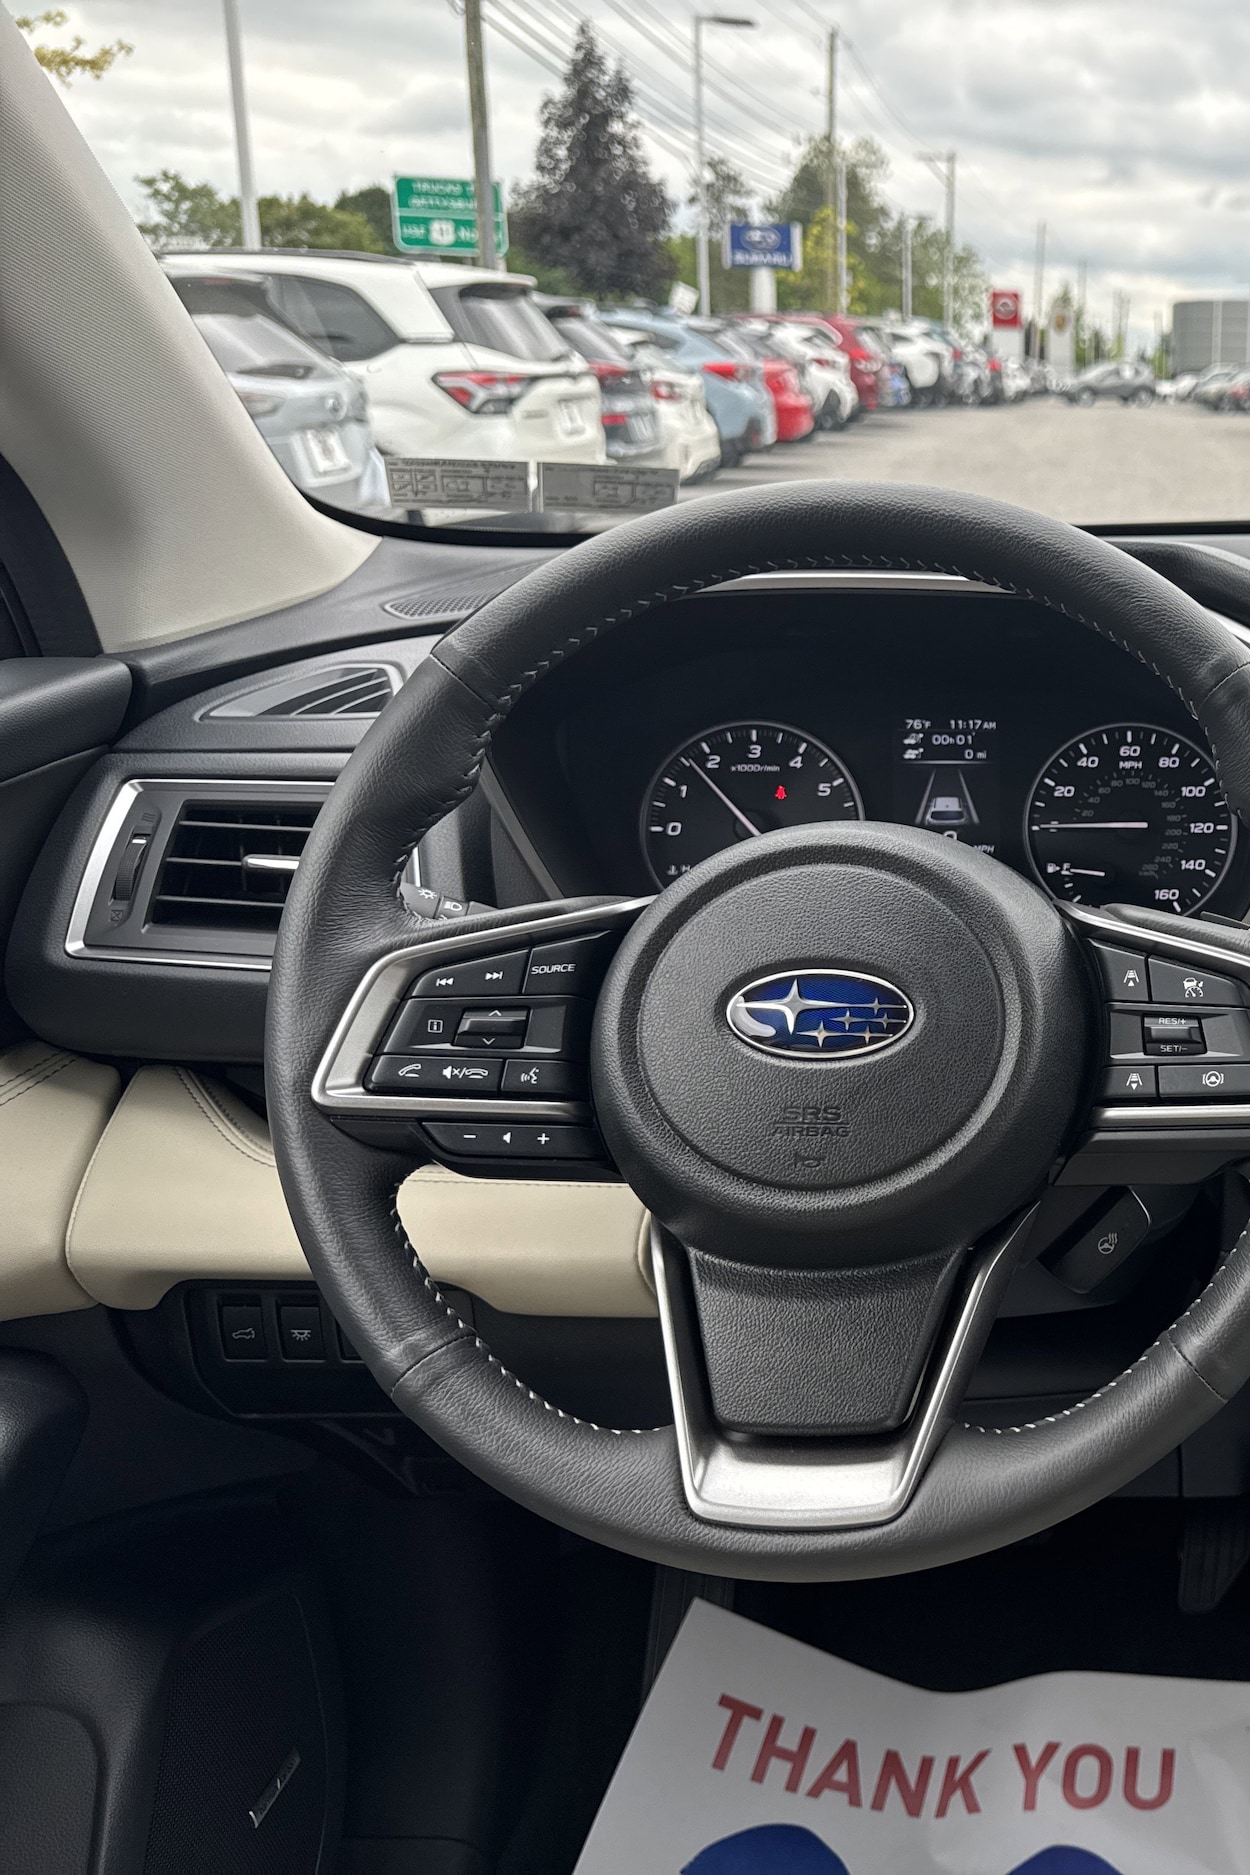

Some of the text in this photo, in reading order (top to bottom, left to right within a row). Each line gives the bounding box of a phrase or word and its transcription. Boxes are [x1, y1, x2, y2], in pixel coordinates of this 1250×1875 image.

[747, 744, 762, 759] 3
[964, 749, 987, 759] 0 mi
[1119, 745, 1141, 757] 60
[706, 755, 721, 769] 2
[789, 756, 803, 769] 4
[1076, 756, 1099, 767] 40
[1119, 761, 1143, 769] MPH
[1158, 757, 1180, 768] 80
[679, 785, 688, 798] 1
[817, 783, 831, 797] 5
[1053, 785, 1075, 797] 20
[1181, 786, 1206, 797] 100
[666, 822, 682, 836] 0
[1189, 822, 1214, 833] 120
[1180, 859, 1206, 870] 140
[1154, 889, 1180, 900] 160
[531, 963, 576, 975] SOURCE
[1158, 1017, 1187, 1025] RES/+
[783, 1105, 842, 1121] SRS
[774, 1126, 850, 1138] AIRBAG
[711, 1692, 1176, 1819] THANK YOU
